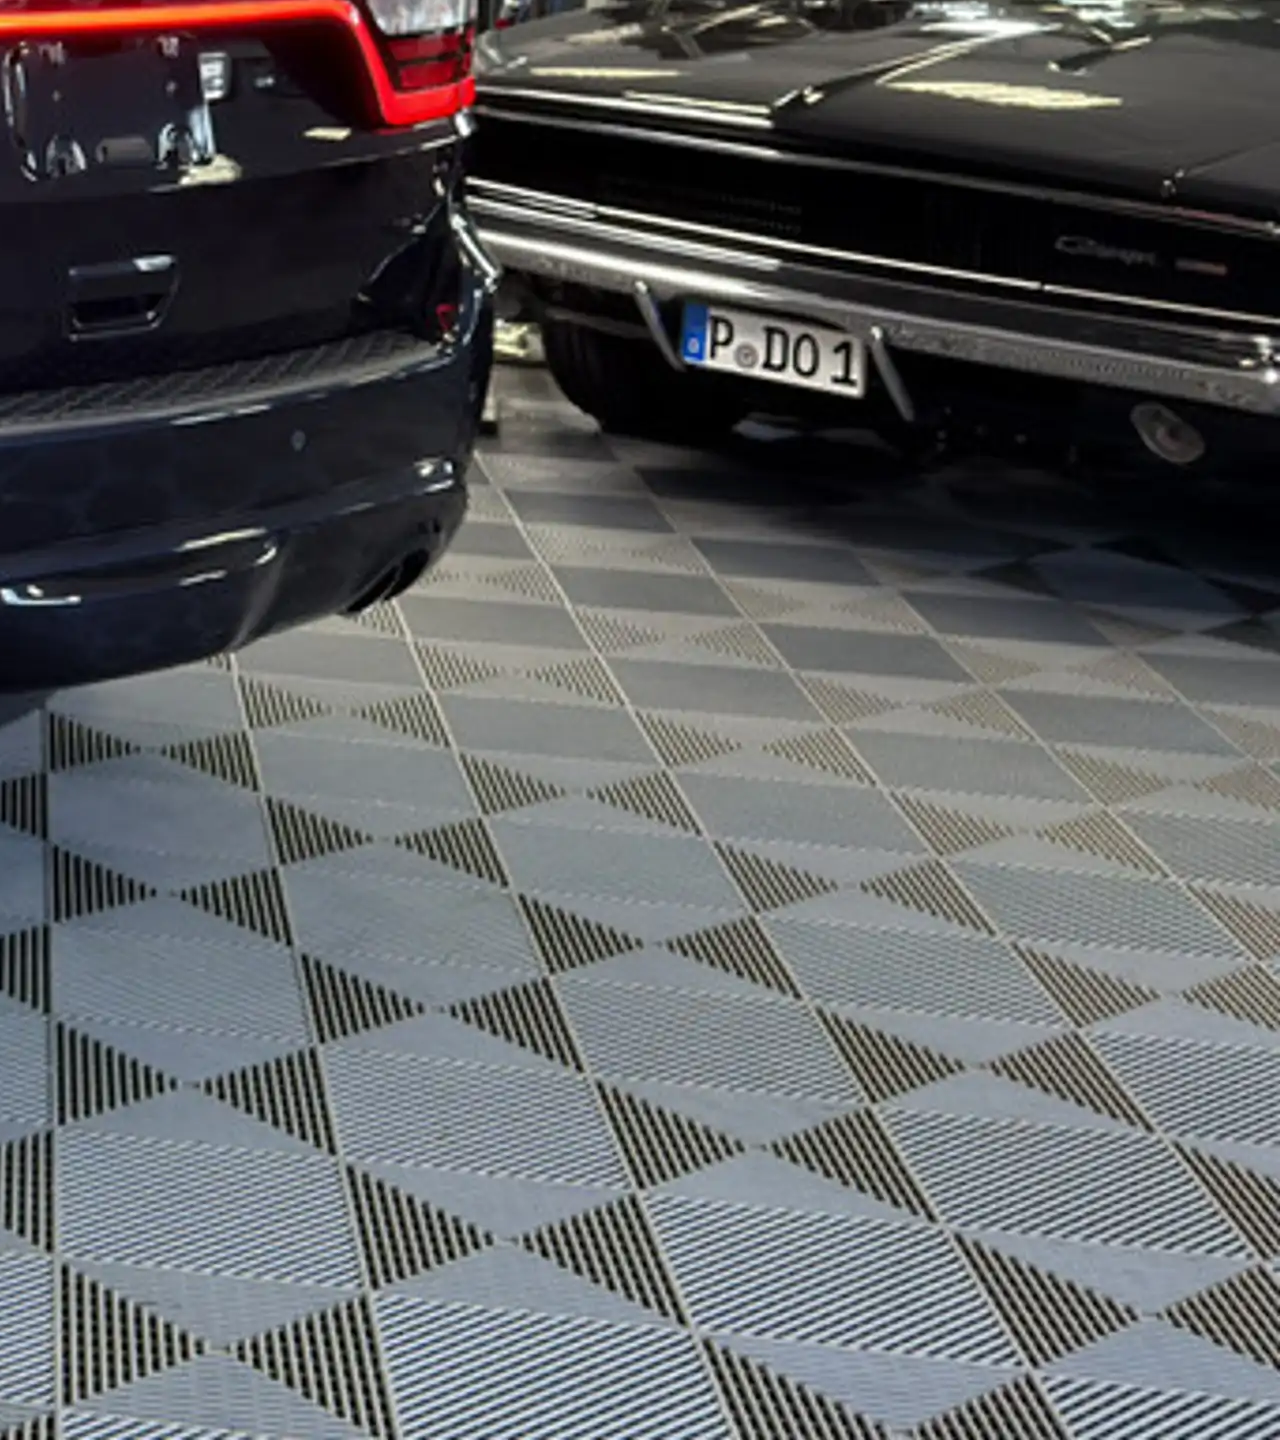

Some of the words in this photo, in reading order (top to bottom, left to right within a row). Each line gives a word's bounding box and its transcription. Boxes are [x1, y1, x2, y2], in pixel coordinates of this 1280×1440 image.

[710, 315, 734, 359] P
[761, 325, 821, 379] DO
[831, 341, 858, 387] 1
